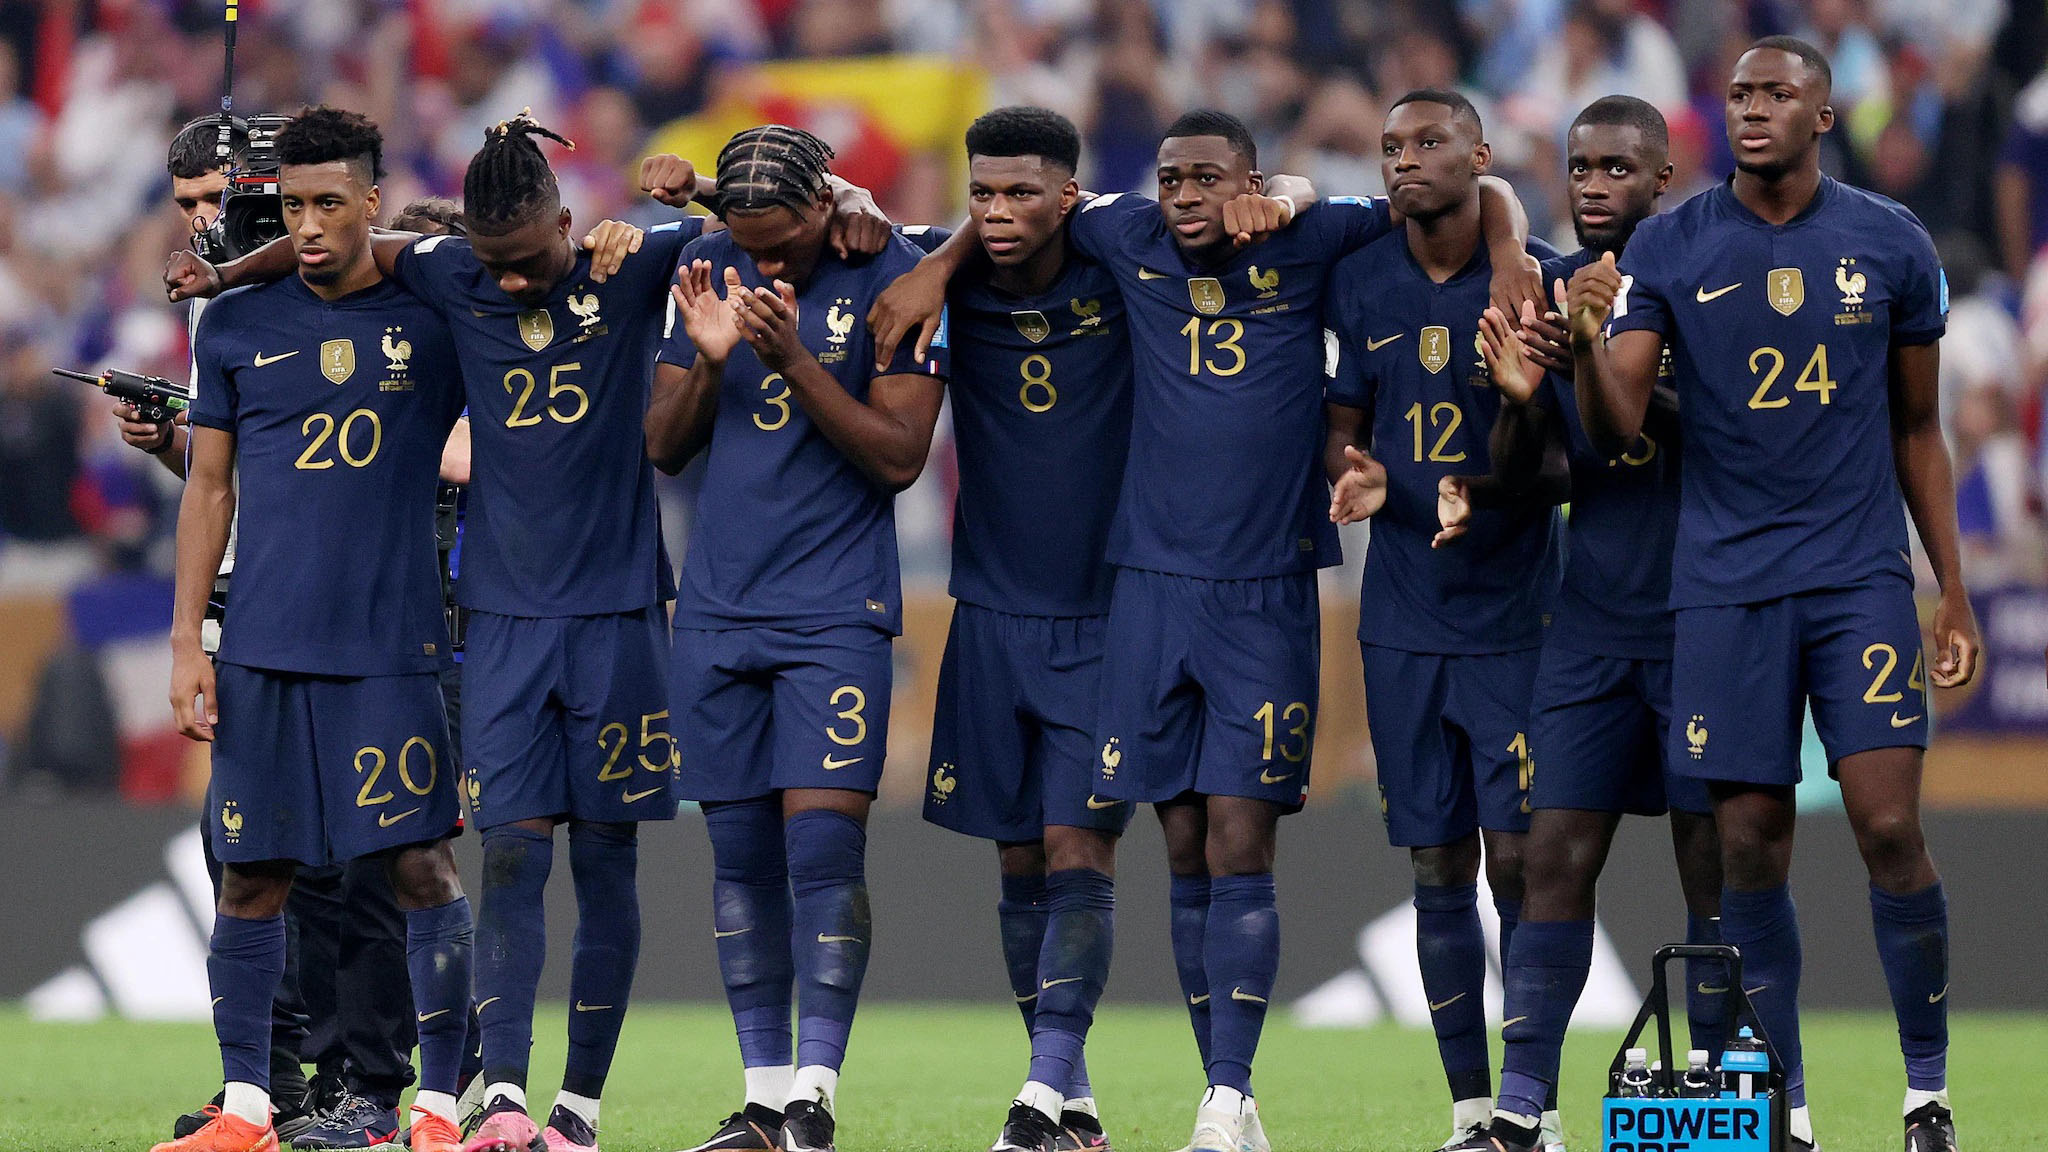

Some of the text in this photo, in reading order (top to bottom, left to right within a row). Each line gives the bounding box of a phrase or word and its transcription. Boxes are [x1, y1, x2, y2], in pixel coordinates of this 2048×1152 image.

[1180, 317, 1246, 377] 13
[1746, 343, 1838, 411] 24
[503, 362, 590, 428] 25
[753, 372, 792, 431] 3
[1019, 354, 1057, 413] 8
[294, 408, 382, 470] 20
[1405, 401, 1467, 463] 12
[1861, 642, 1926, 706] 24
[597, 709, 671, 782] 25
[826, 685, 867, 745] 3
[1253, 701, 1310, 764] 13
[354, 736, 436, 807] 20
[1506, 731, 1529, 791] 1
[1609, 1107, 1760, 1140] POWER
